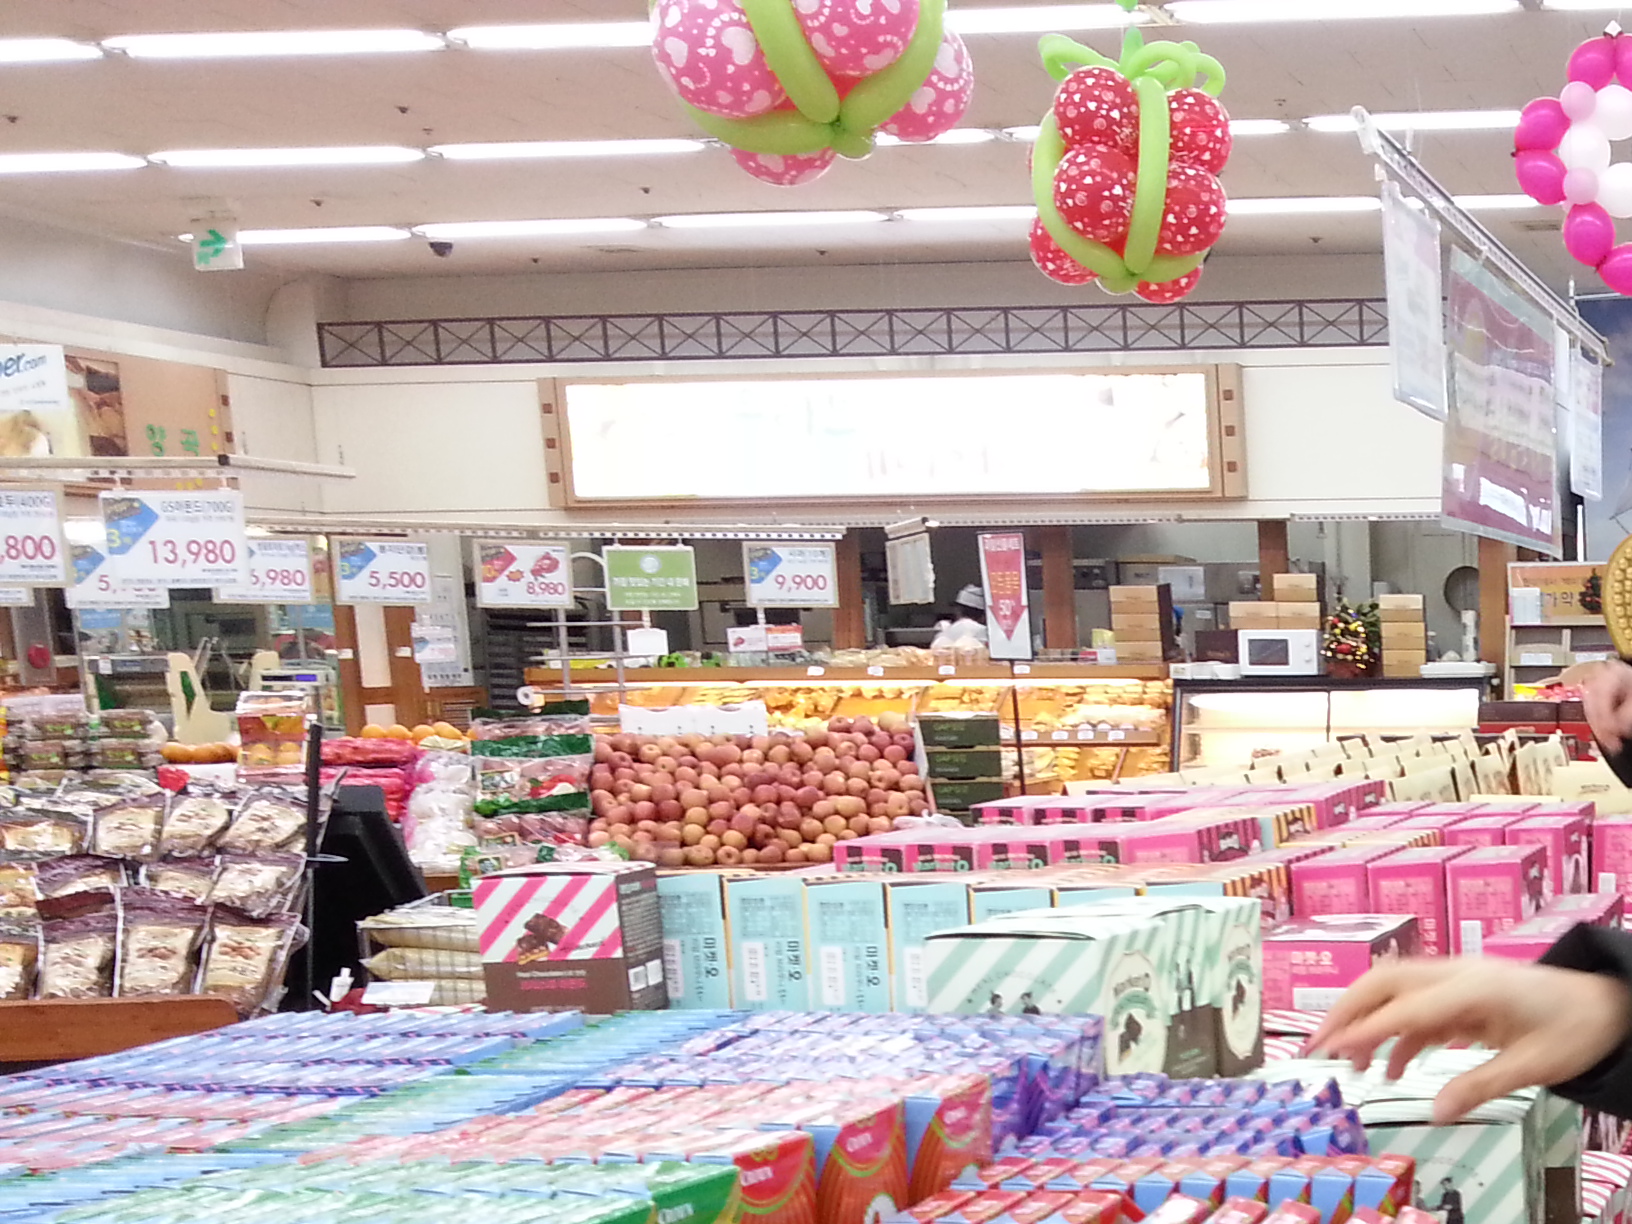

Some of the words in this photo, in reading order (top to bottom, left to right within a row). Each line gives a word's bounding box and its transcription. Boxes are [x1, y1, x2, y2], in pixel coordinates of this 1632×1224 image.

[149, 539, 236, 567] 13,980
[368, 571, 426, 590] 5,500
[526, 581, 565, 597] 8,980
[774, 573, 828, 593] 9,900
